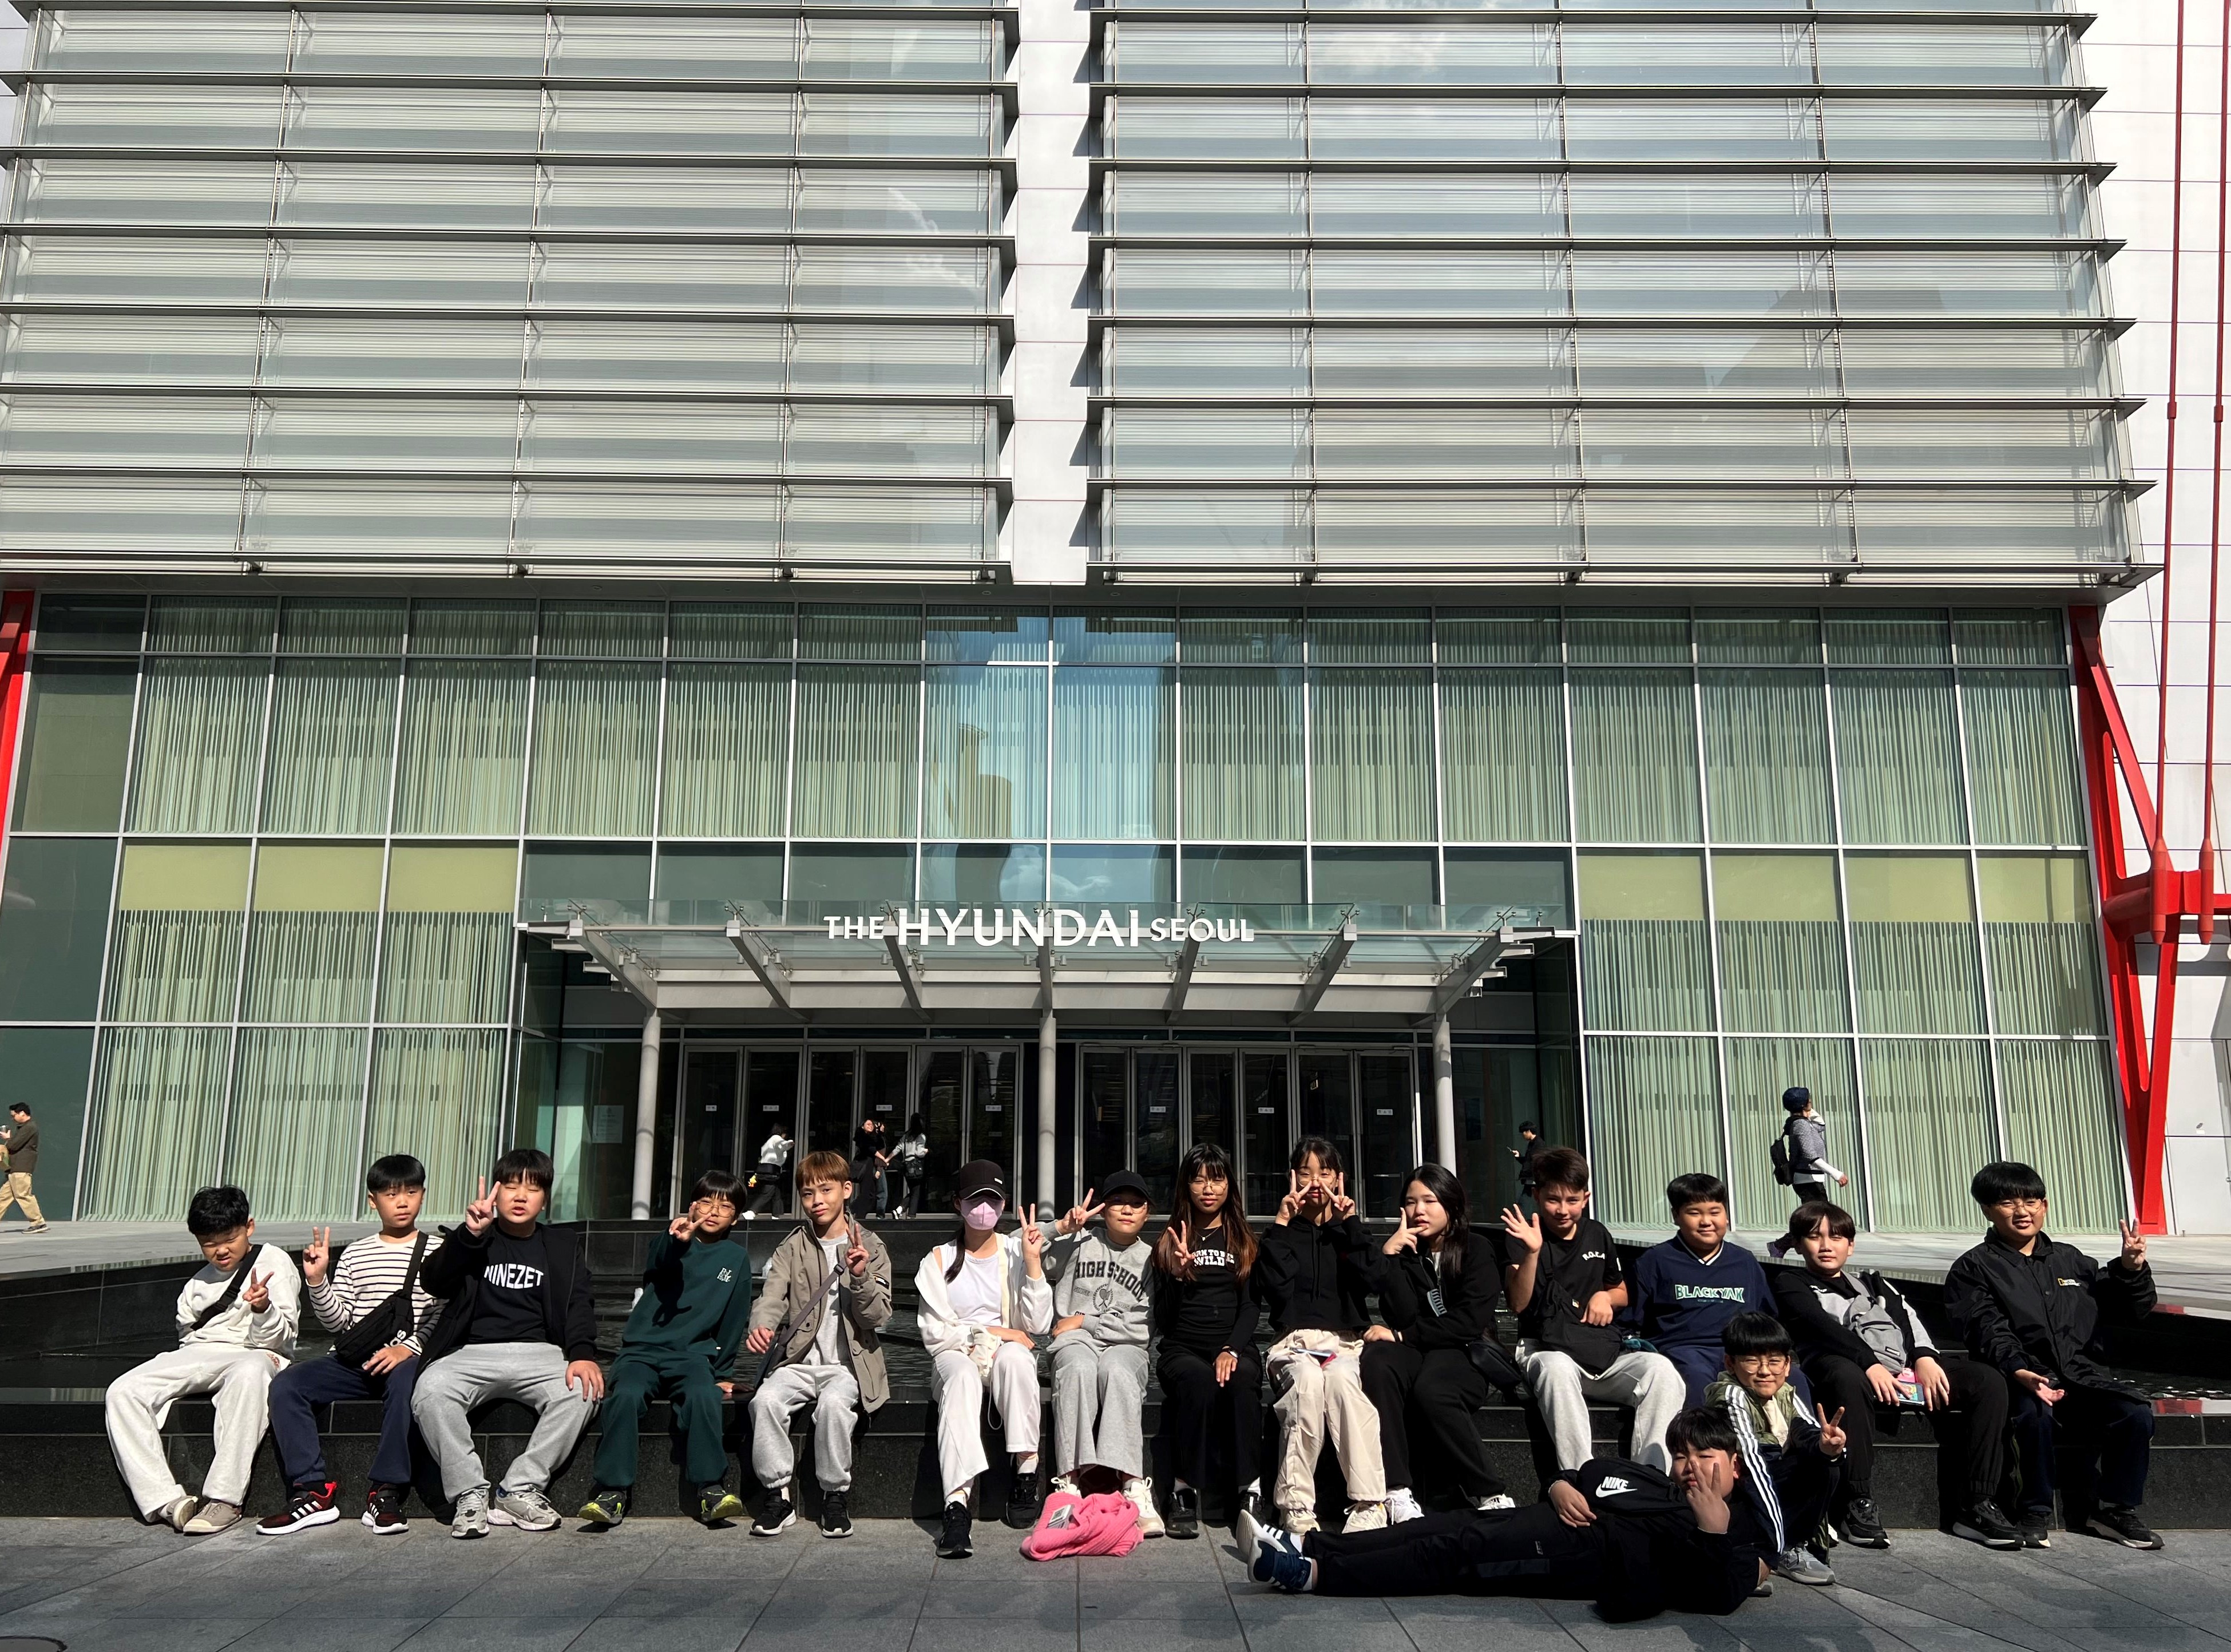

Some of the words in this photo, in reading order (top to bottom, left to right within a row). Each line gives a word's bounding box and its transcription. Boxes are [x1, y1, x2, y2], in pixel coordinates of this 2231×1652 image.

[823, 916, 885, 940] THE
[898, 908, 1139, 947] HYUNDAI
[1150, 918, 1254, 942] SEOUL
[1076, 1260, 1106, 1278] HIGH
[1194, 1255, 1225, 1266] WILD
[484, 1263, 544, 1289] NINEZET
[1601, 1476, 1629, 1490] NIKE
